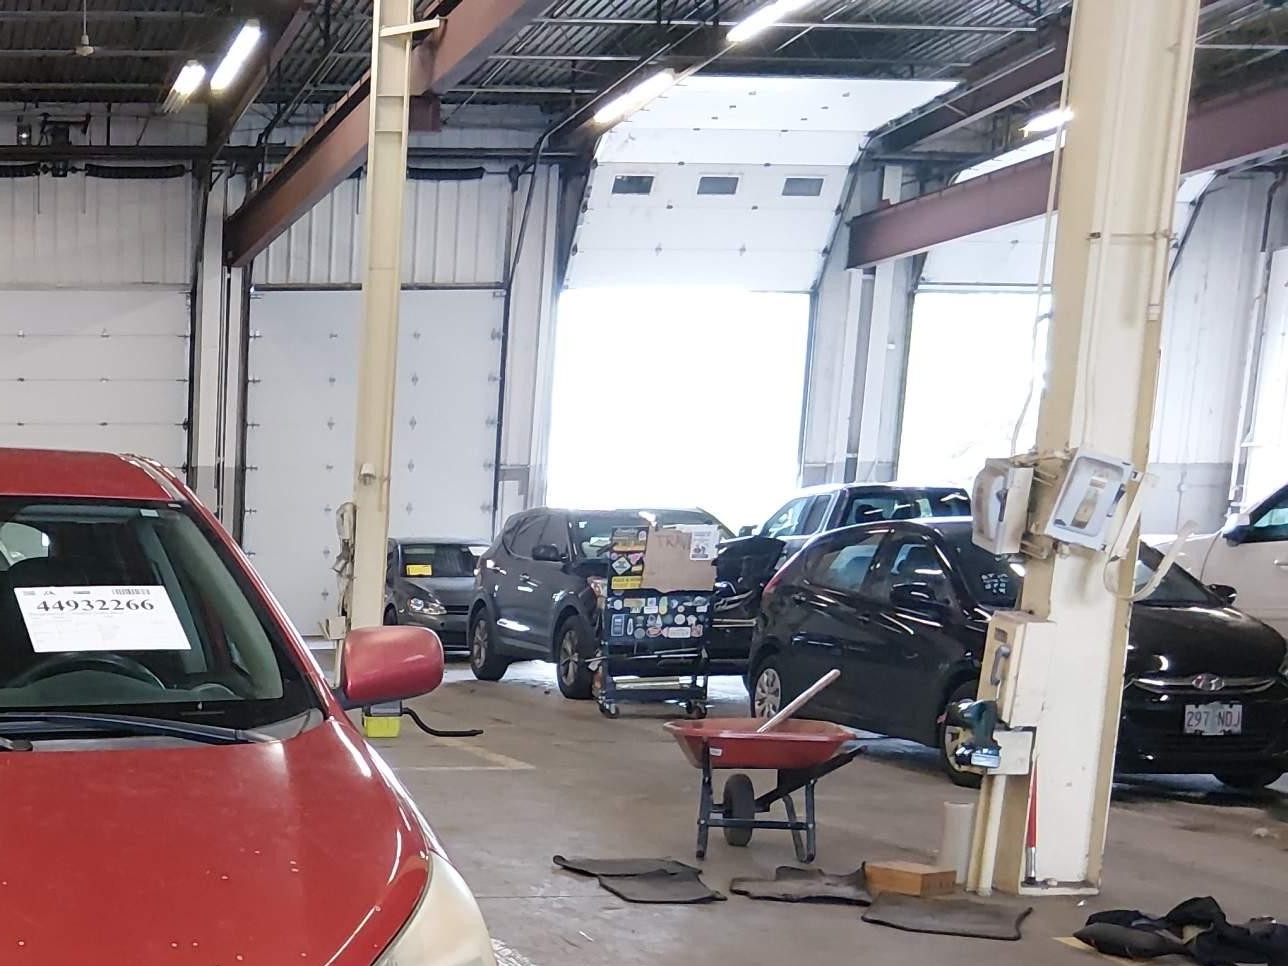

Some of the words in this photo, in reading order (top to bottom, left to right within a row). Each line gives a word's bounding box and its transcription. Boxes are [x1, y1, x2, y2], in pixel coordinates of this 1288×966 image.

[37, 599, 154, 611] 44932266
[1187, 711, 1209, 727] 297
[1217, 711, 1240, 727] NDJ
